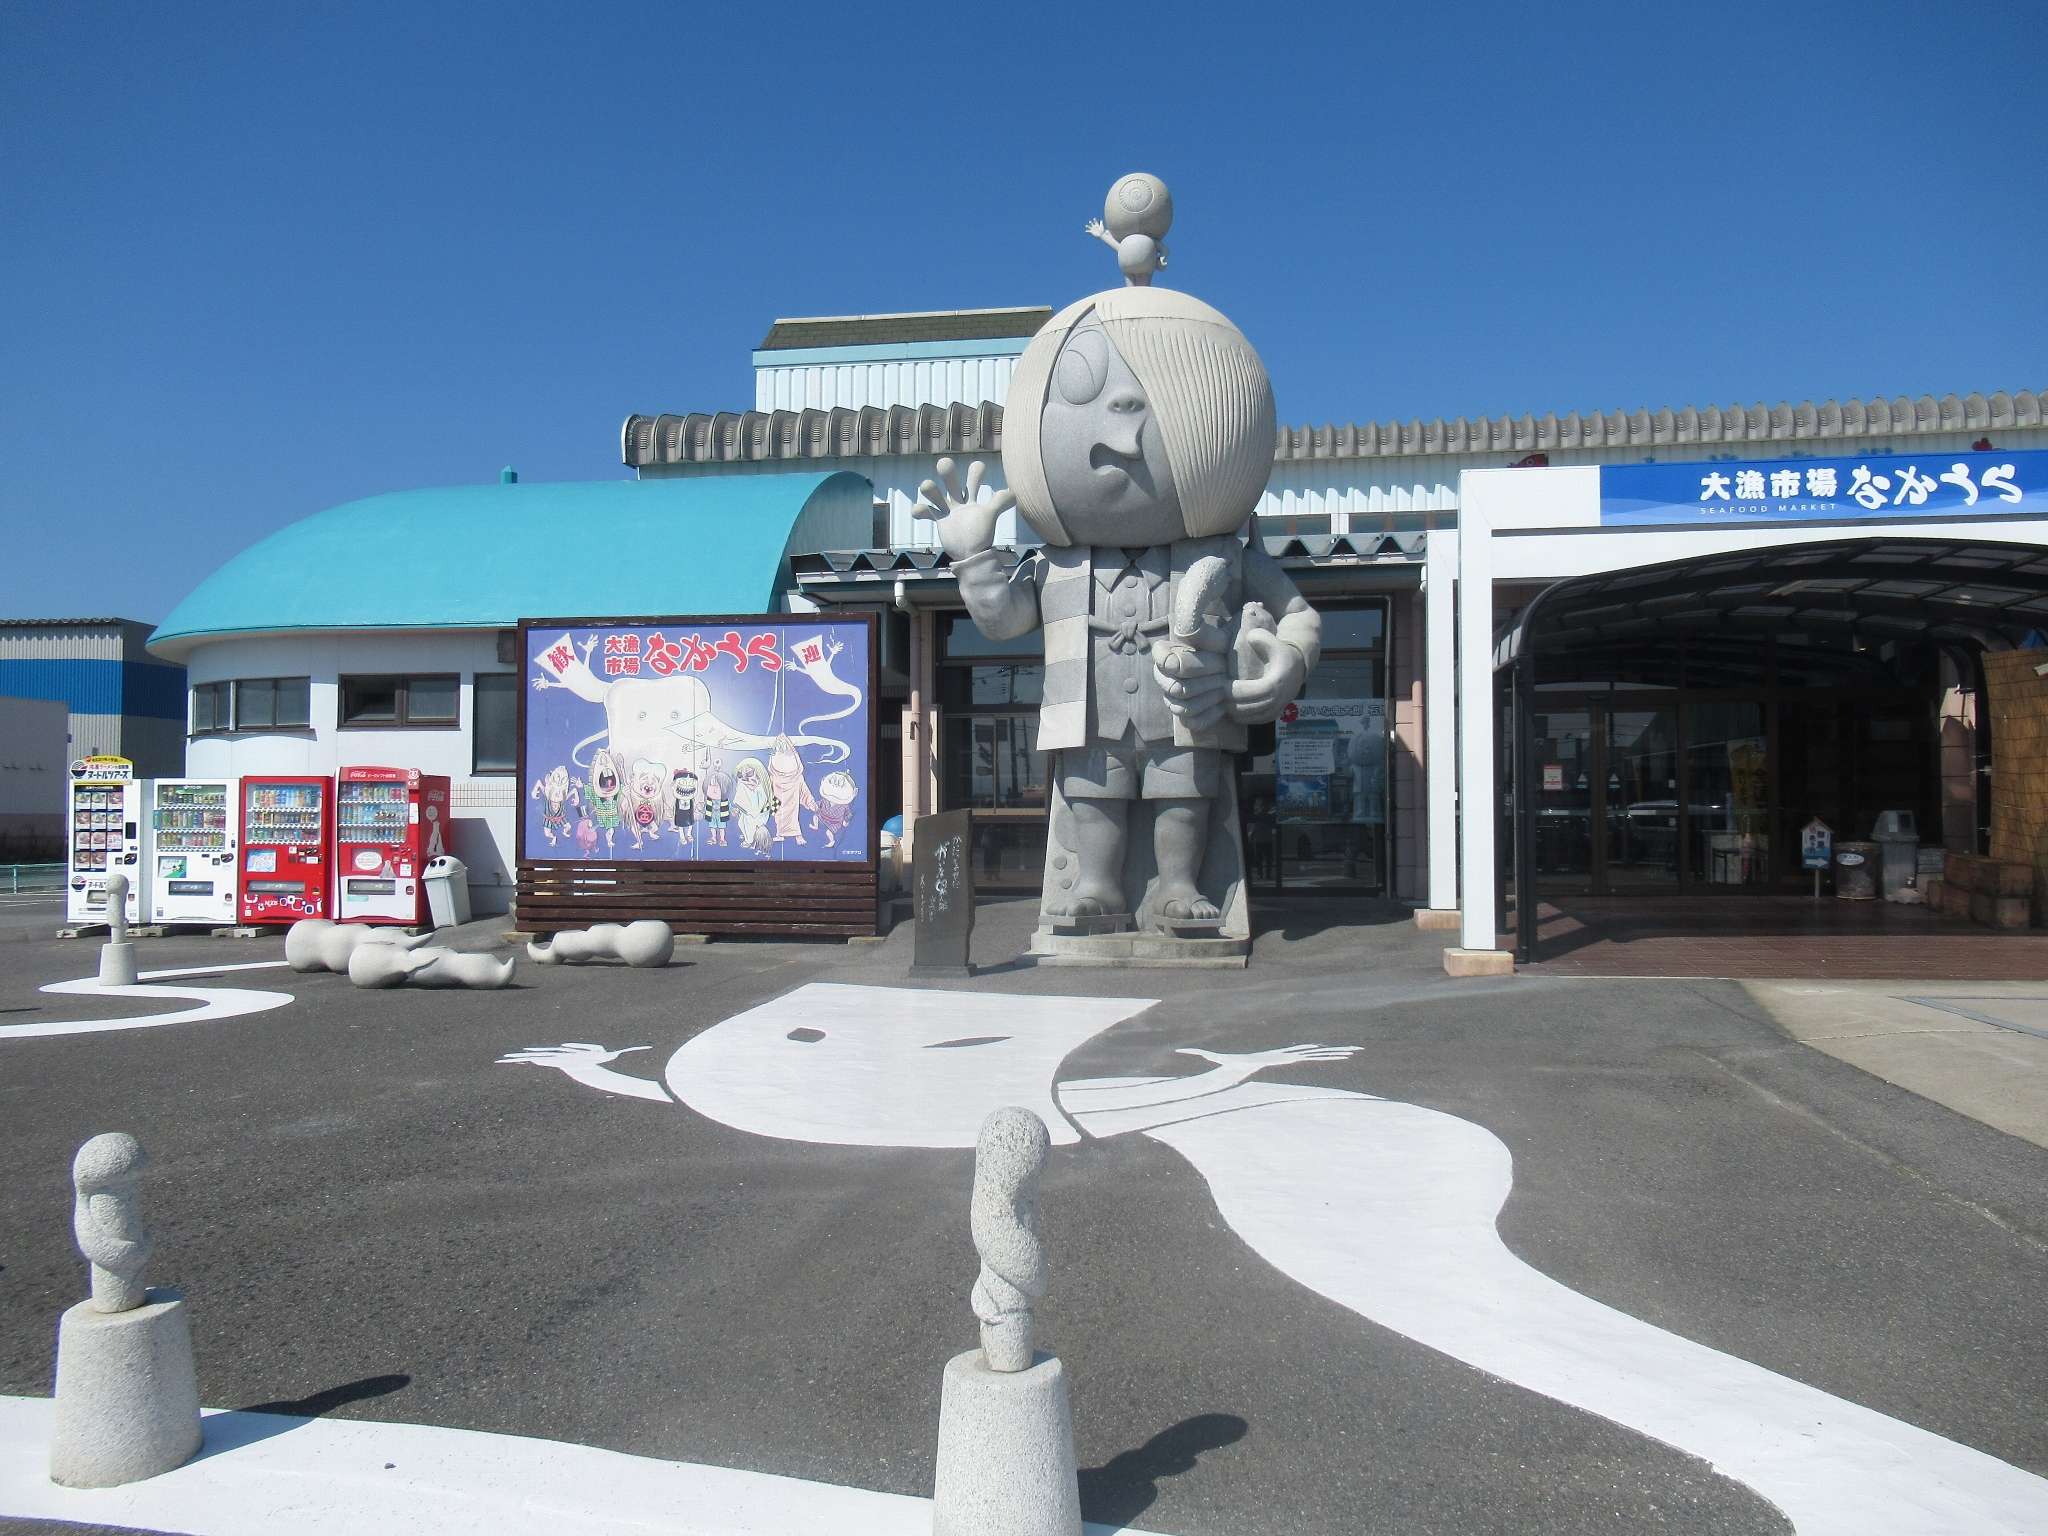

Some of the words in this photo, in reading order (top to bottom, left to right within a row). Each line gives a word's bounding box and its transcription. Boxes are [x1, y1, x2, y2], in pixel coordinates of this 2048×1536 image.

[1700, 468, 1838, 501] 大漁市場
[1847, 462, 2024, 510] なかうら
[1700, 505, 1768, 515] SEAFOOD
[1778, 503, 1837, 513] MARKET
[547, 645, 576, 674] 歓
[604, 634, 641, 654] 大漁
[643, 632, 784, 676] なかうら
[801, 644, 821, 664] 迎
[604, 656, 641, 675] 市場
[87, 770, 131, 780] ヌードルツアーズ
